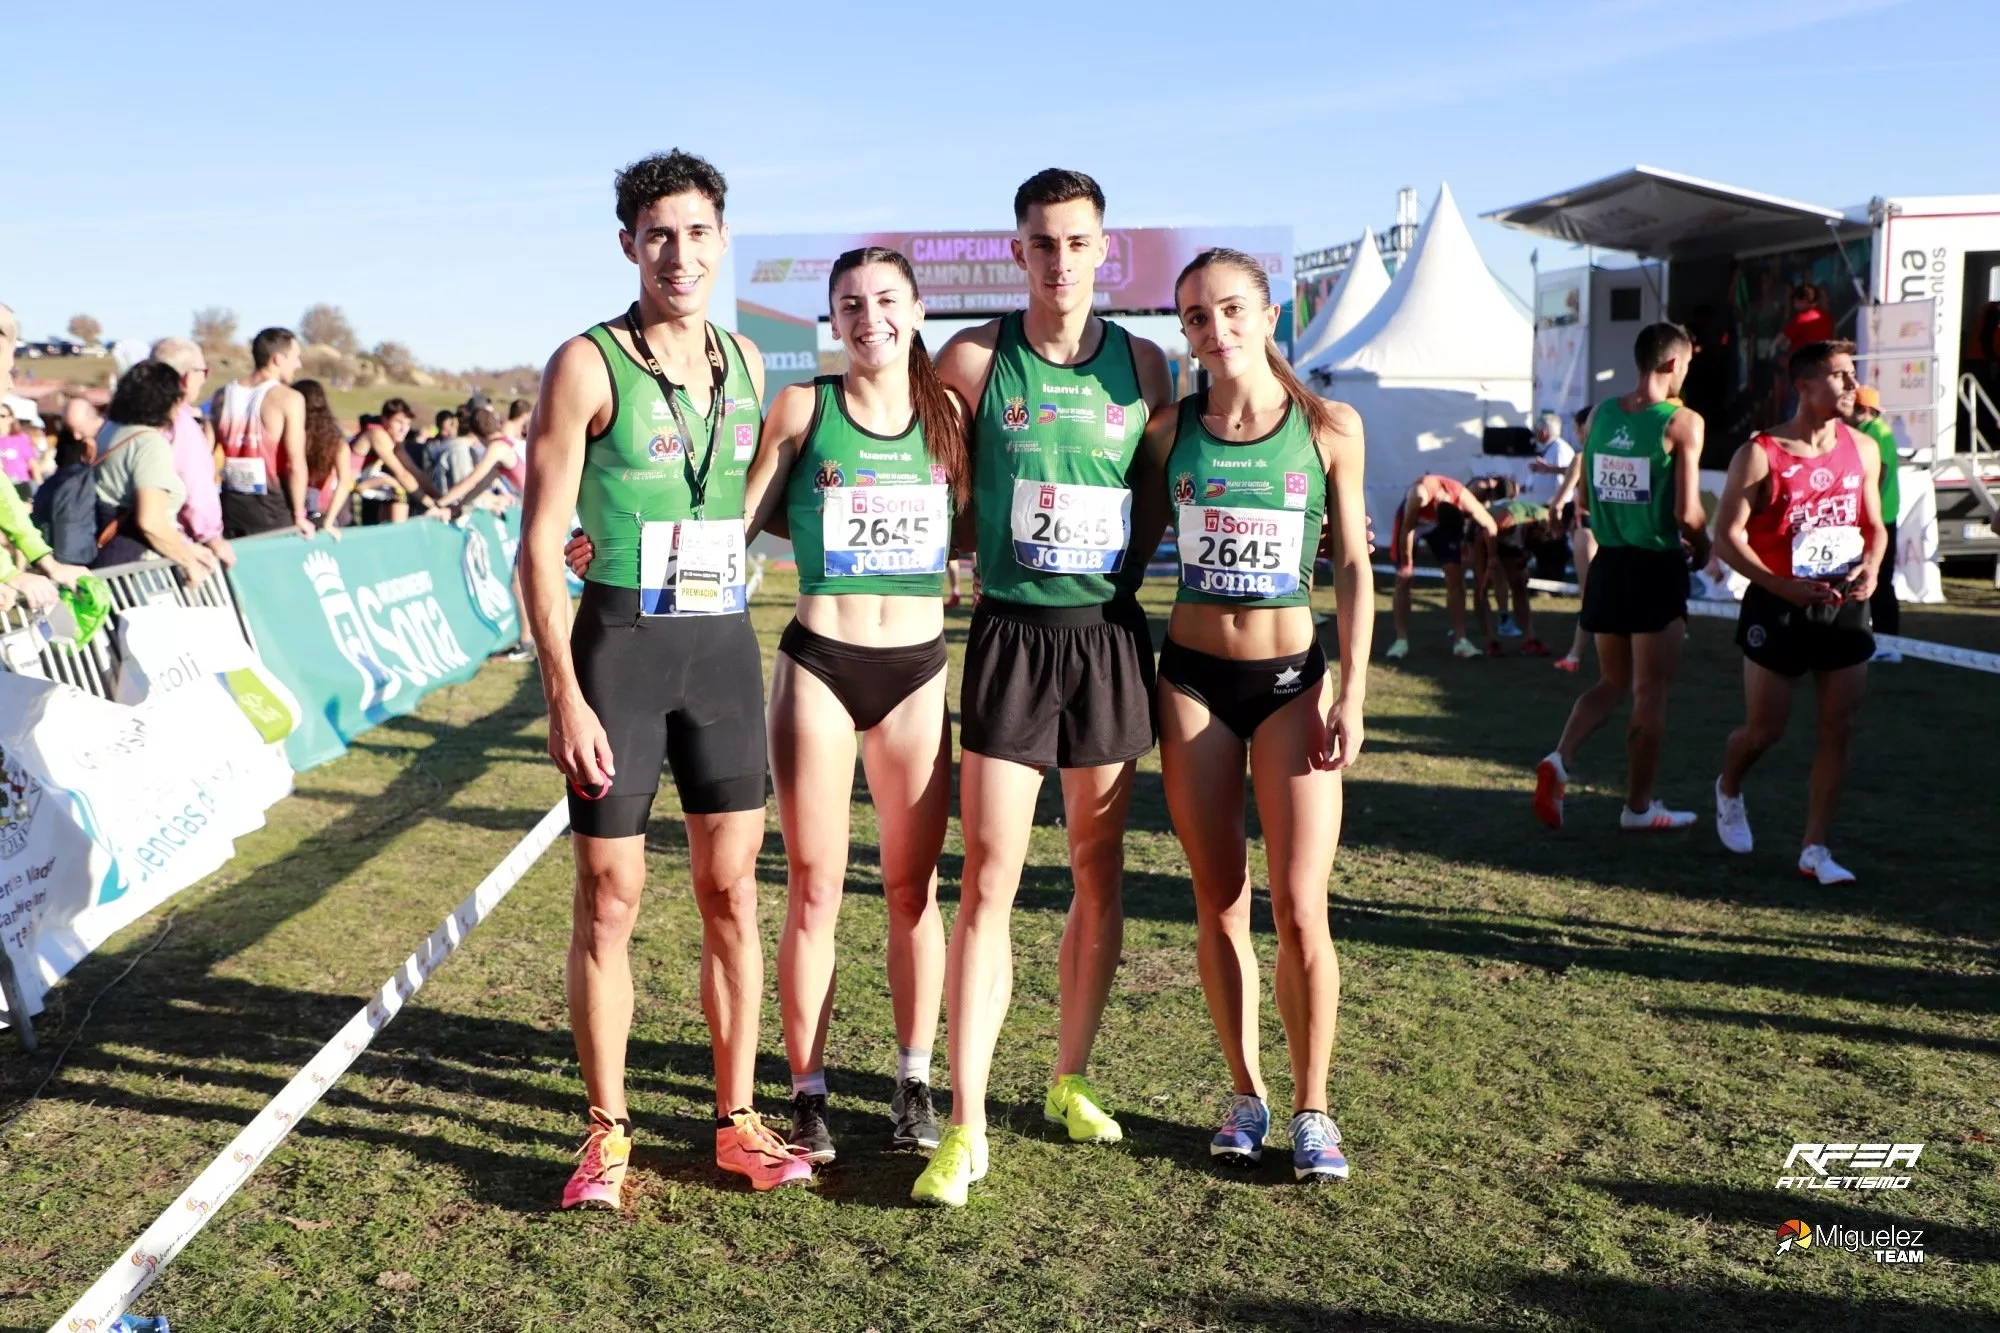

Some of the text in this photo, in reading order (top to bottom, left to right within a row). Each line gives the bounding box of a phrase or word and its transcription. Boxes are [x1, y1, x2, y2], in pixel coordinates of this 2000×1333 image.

[913, 238, 1011, 262] CAMPEONA
[916, 264, 970, 286] CAMPO
[763, 351, 817, 370] oma
[1042, 383, 1079, 395] luanvi
[1213, 458, 1252, 468] luanvi
[1600, 471, 1639, 488] 2642
[872, 496, 925, 513] Soria
[848, 518, 929, 547] 2645
[1032, 513, 1111, 546] 2645
[1222, 516, 1279, 537] Soria
[1033, 547, 1104, 568] Joma
[1199, 536, 1281, 570] 2645
[1201, 570, 1276, 593] Joma
